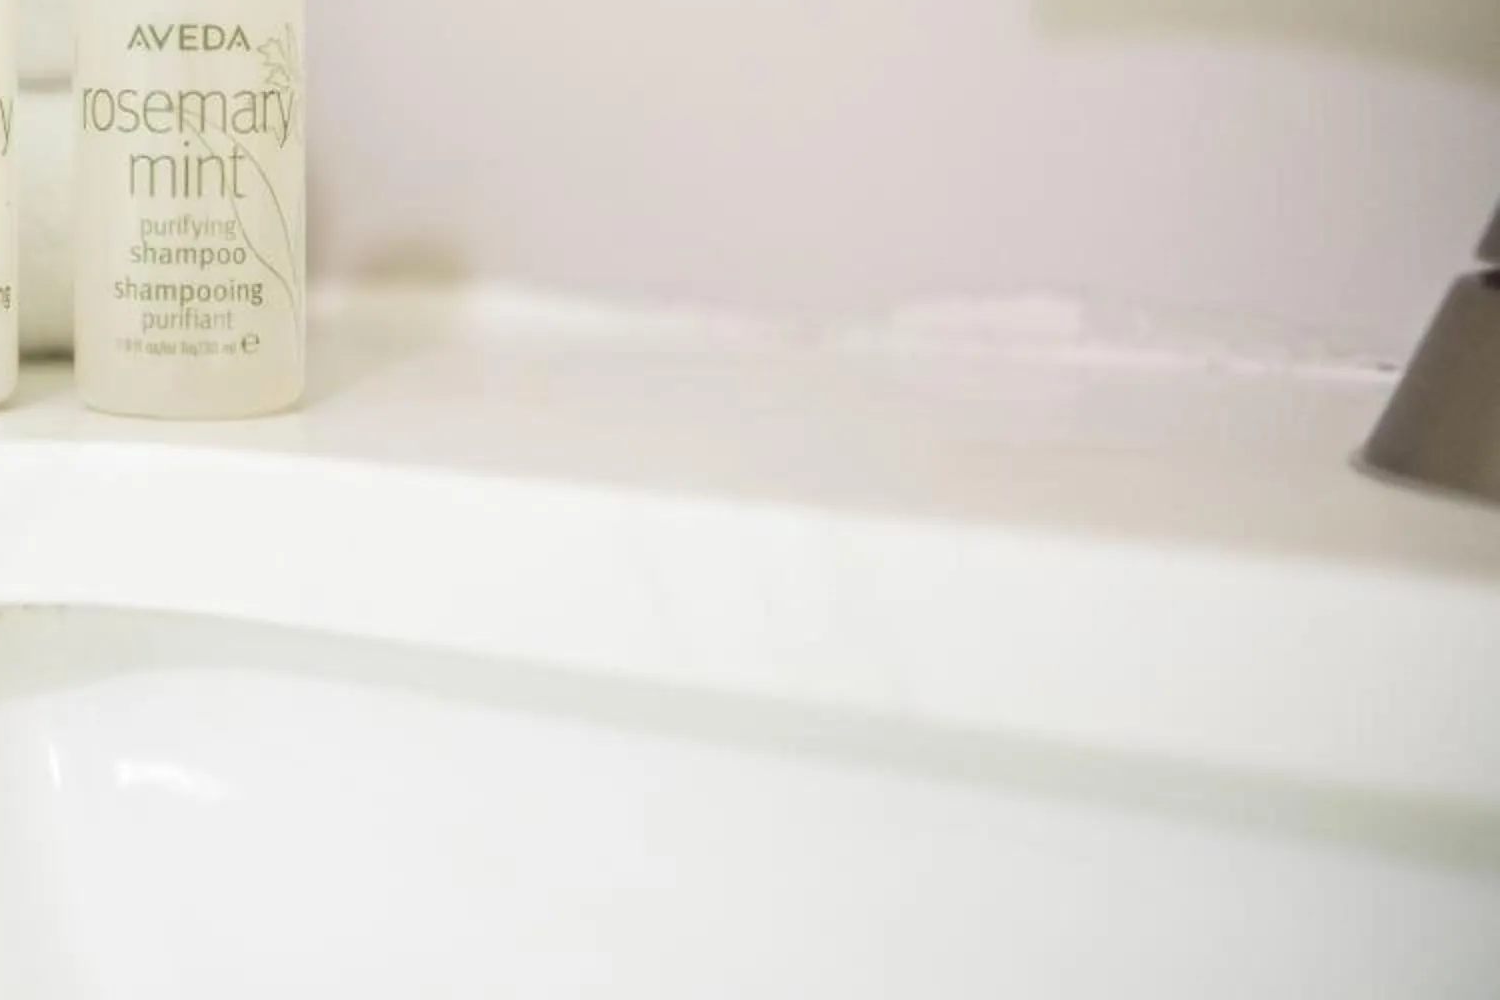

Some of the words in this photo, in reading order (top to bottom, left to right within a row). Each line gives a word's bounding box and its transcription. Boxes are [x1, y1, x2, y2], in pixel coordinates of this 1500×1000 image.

[127, 23, 251, 51] AVEDA
[82, 87, 295, 149] rosemary
[129, 141, 247, 199] mint
[140, 213, 237, 241] purifying
[130, 242, 247, 270] shampoo
[114, 277, 264, 307] shampooing
[142, 308, 235, 335] purifiant
